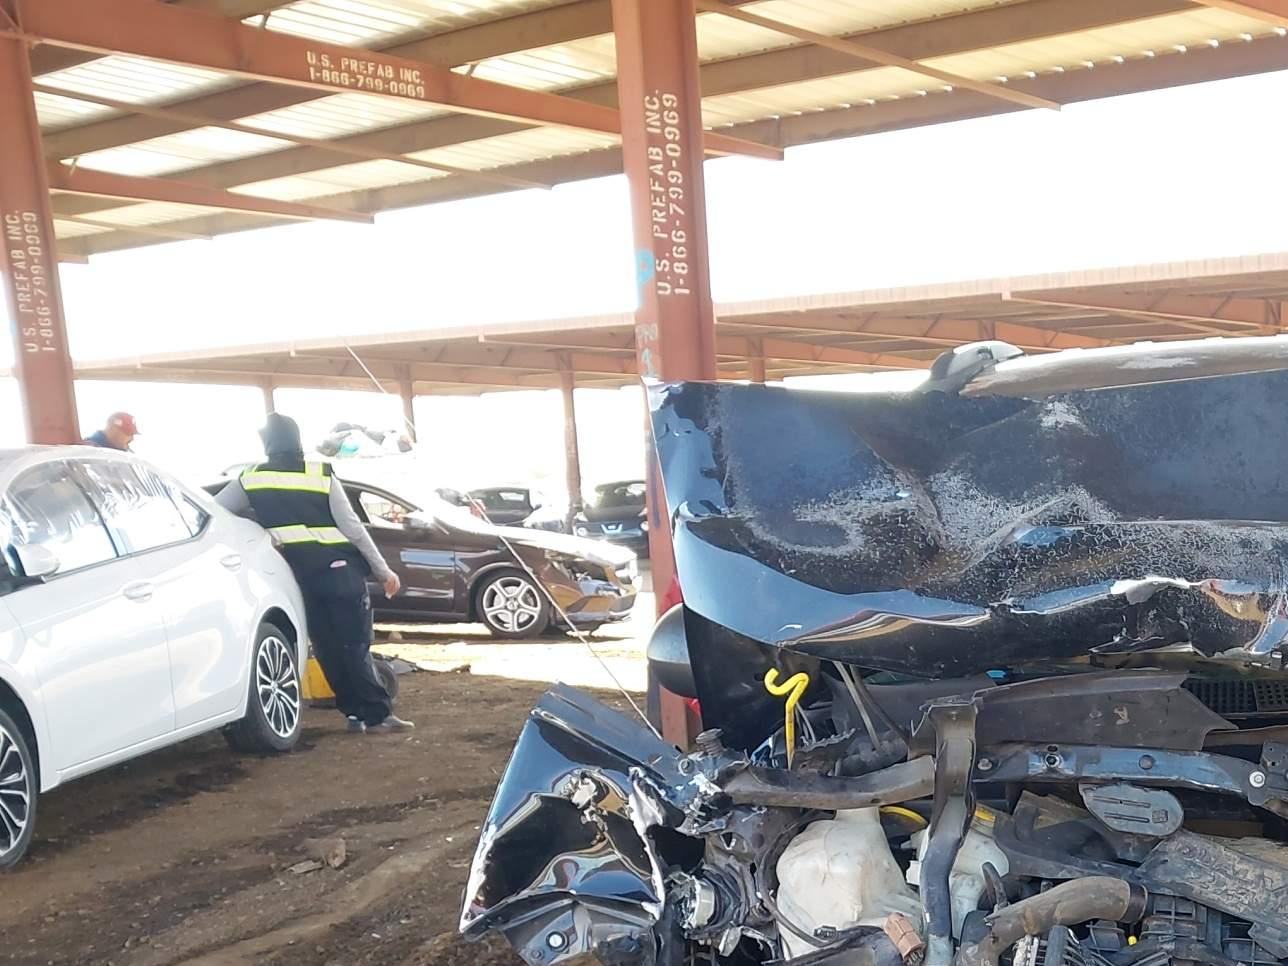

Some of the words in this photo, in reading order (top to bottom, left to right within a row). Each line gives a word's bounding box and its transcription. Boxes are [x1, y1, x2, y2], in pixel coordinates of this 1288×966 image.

[306, 51, 335, 68] U.S.
[341, 57, 395, 79] PREFAB
[399, 67, 425, 85] INC.
[309, 66, 425, 98] 1-866-799-0969
[644, 89, 662, 134] INC.
[647, 147, 668, 239] PREFAB
[662, 93, 691, 295] 1-866-799-0969
[5, 209, 23, 241] INC.
[10, 249, 34, 313] PREFAB
[22, 212, 57, 352] 1-866-799-0969
[655, 251, 672, 295] U.S.
[23, 322, 39, 353] U.S.
